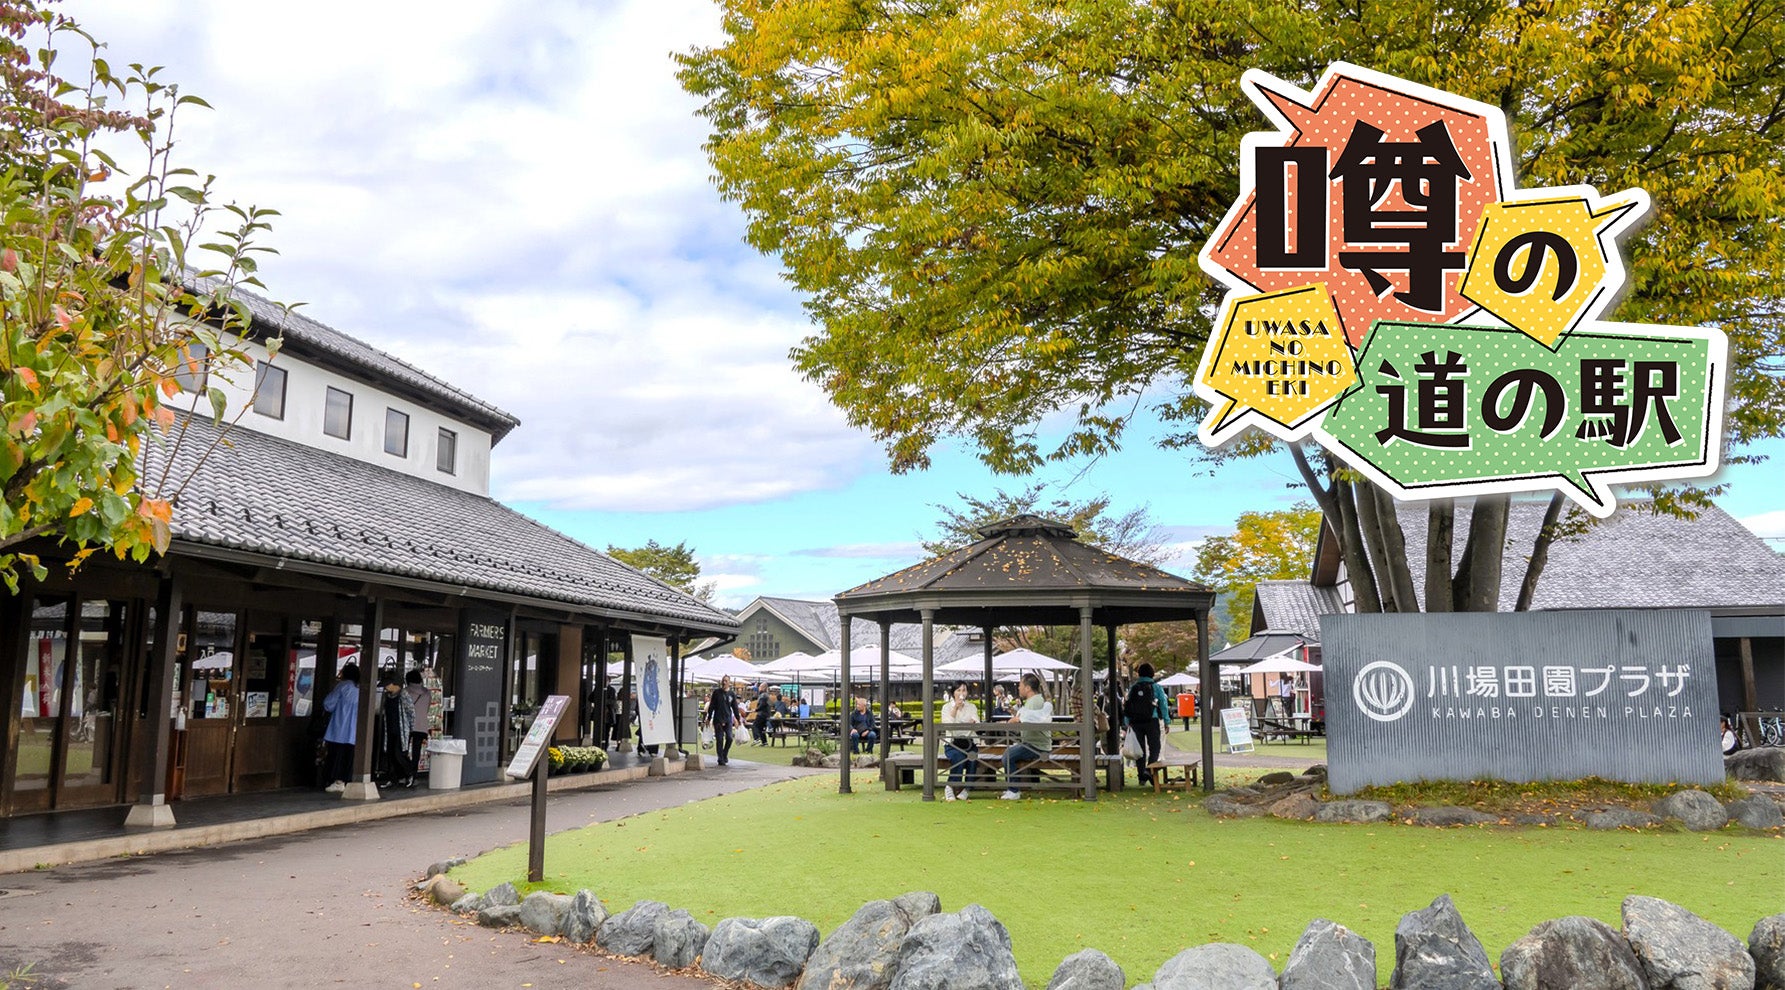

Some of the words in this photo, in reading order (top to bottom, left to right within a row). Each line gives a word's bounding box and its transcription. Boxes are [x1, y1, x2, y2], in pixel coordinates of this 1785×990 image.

[470, 623, 504, 640] FARMERS
[468, 644, 499, 659] MARKET
[1427, 664, 1691, 698] 川場田園プラザ
[1432, 706, 1516, 719] KAWABA
[1534, 706, 1607, 719] DENEN
[1624, 706, 1692, 719] PLAZA
